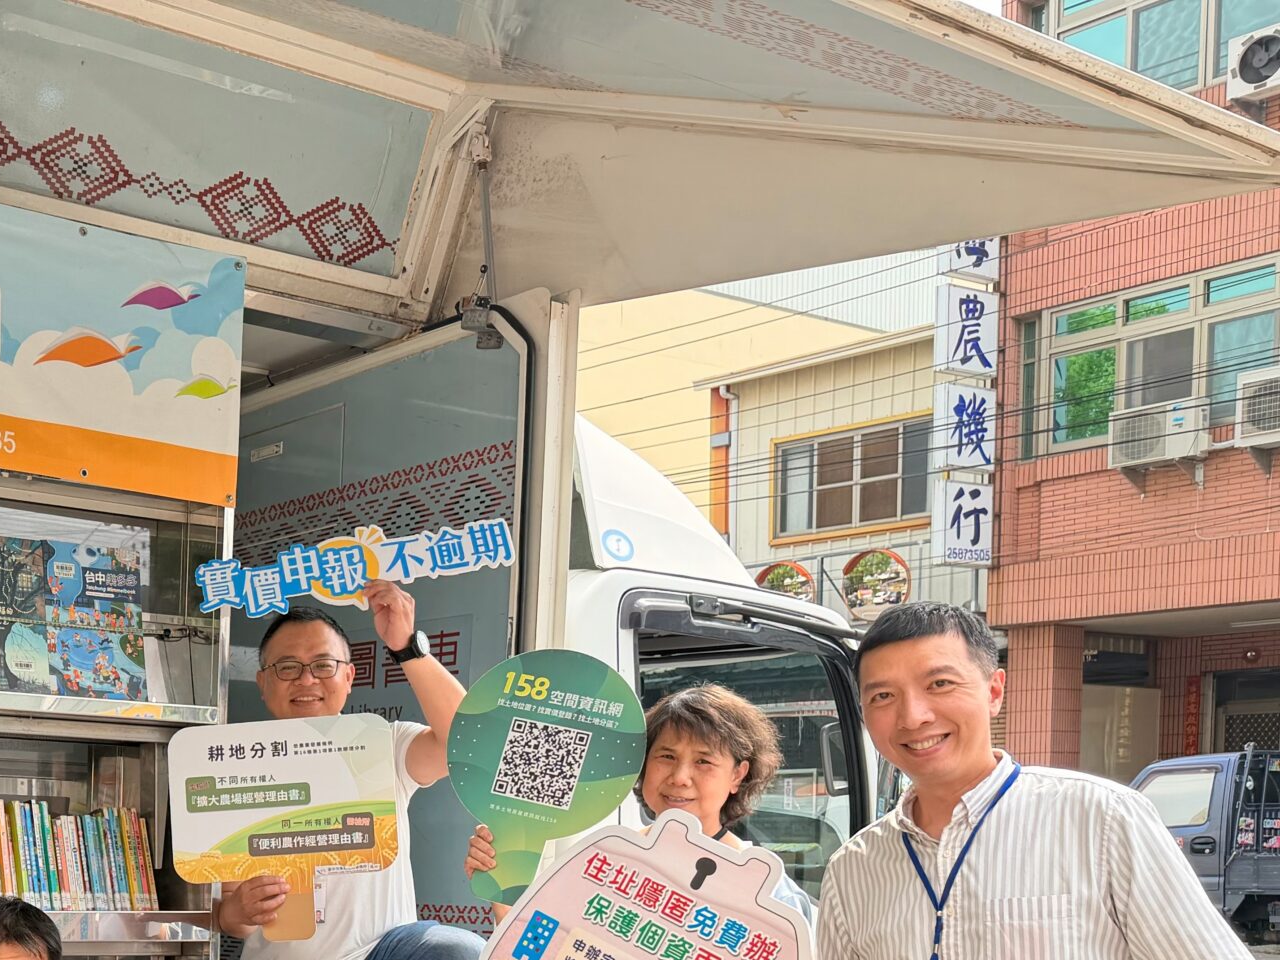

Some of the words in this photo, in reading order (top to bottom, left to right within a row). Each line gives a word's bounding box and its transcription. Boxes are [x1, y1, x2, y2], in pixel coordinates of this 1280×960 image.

[196, 545, 368, 615] 實價申報
[380, 521, 512, 581] 不逾期
[503, 671, 551, 701] 158
[549, 690, 625, 718] 空間資訊網
[207, 740, 289, 763] 耕地分割
[217, 774, 276, 786] 不同所有權人
[191, 788, 306, 807] 『擴大農場經營理由書』
[281, 817, 341, 829] 同一所有權人
[252, 832, 369, 850] 『便利農作經營理由書』
